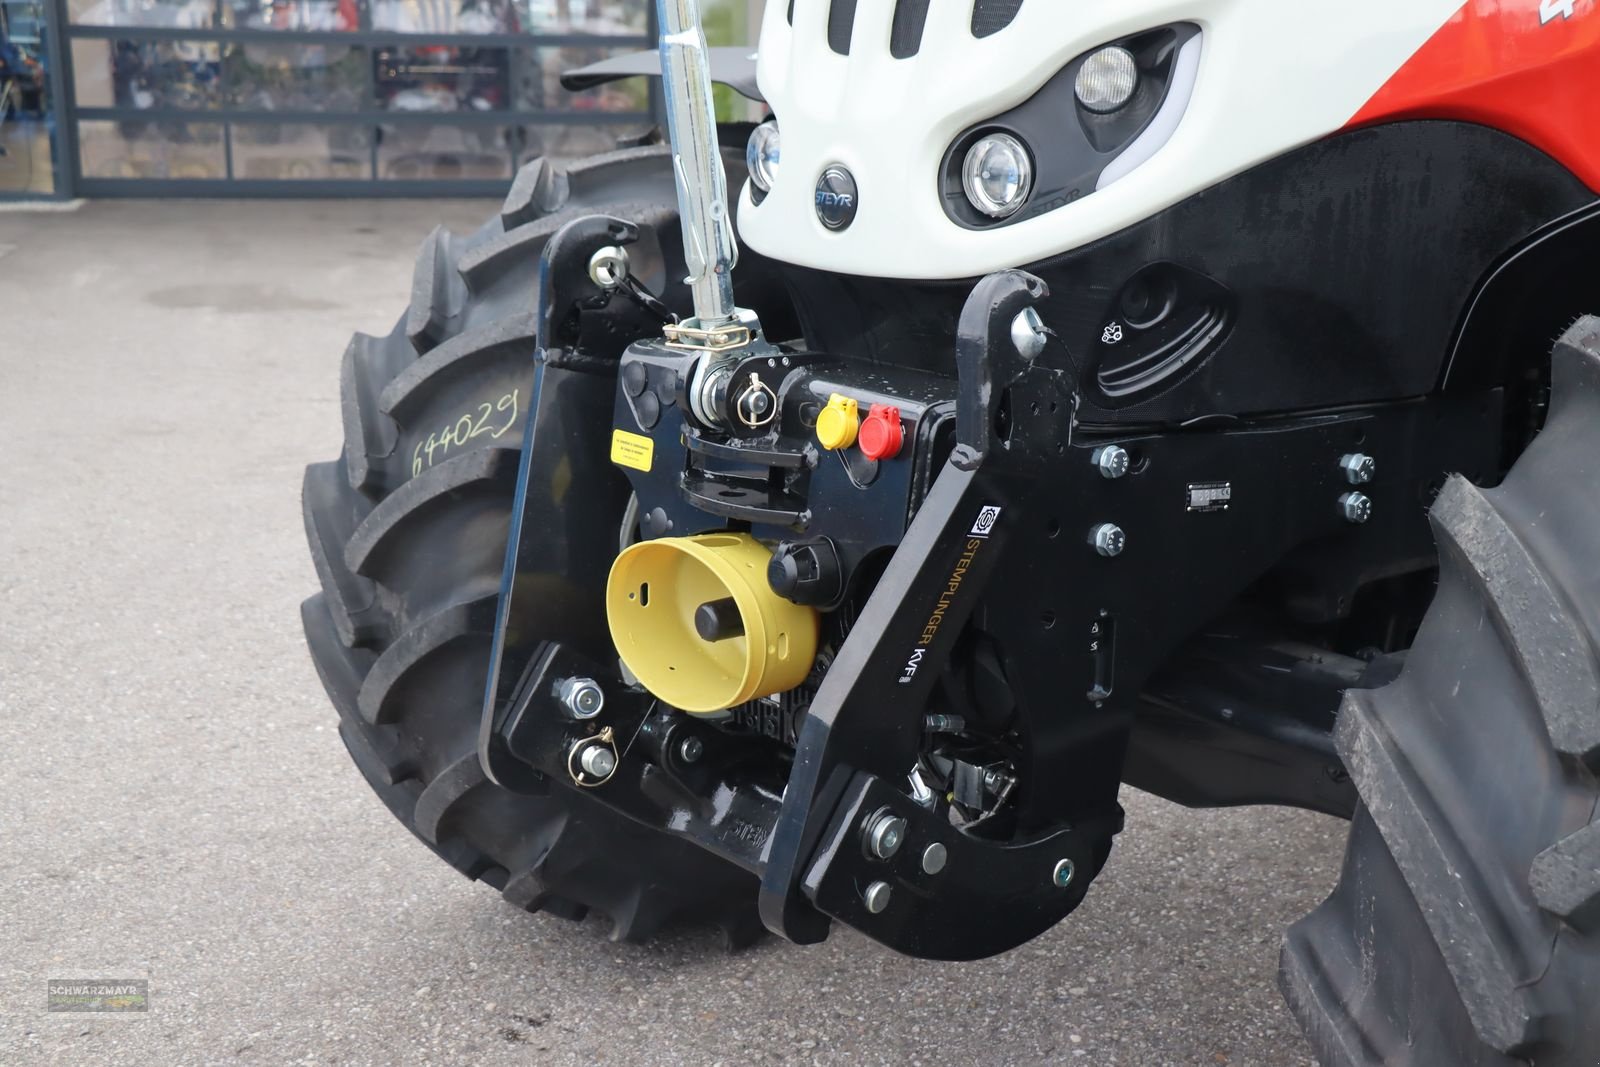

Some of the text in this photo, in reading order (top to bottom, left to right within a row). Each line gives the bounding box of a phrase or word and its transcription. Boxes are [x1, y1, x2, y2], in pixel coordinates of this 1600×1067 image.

[816, 191, 853, 207] STEYR
[412, 388, 519, 478] 644029
[905, 538, 981, 676] STEMPLINGER KVF
